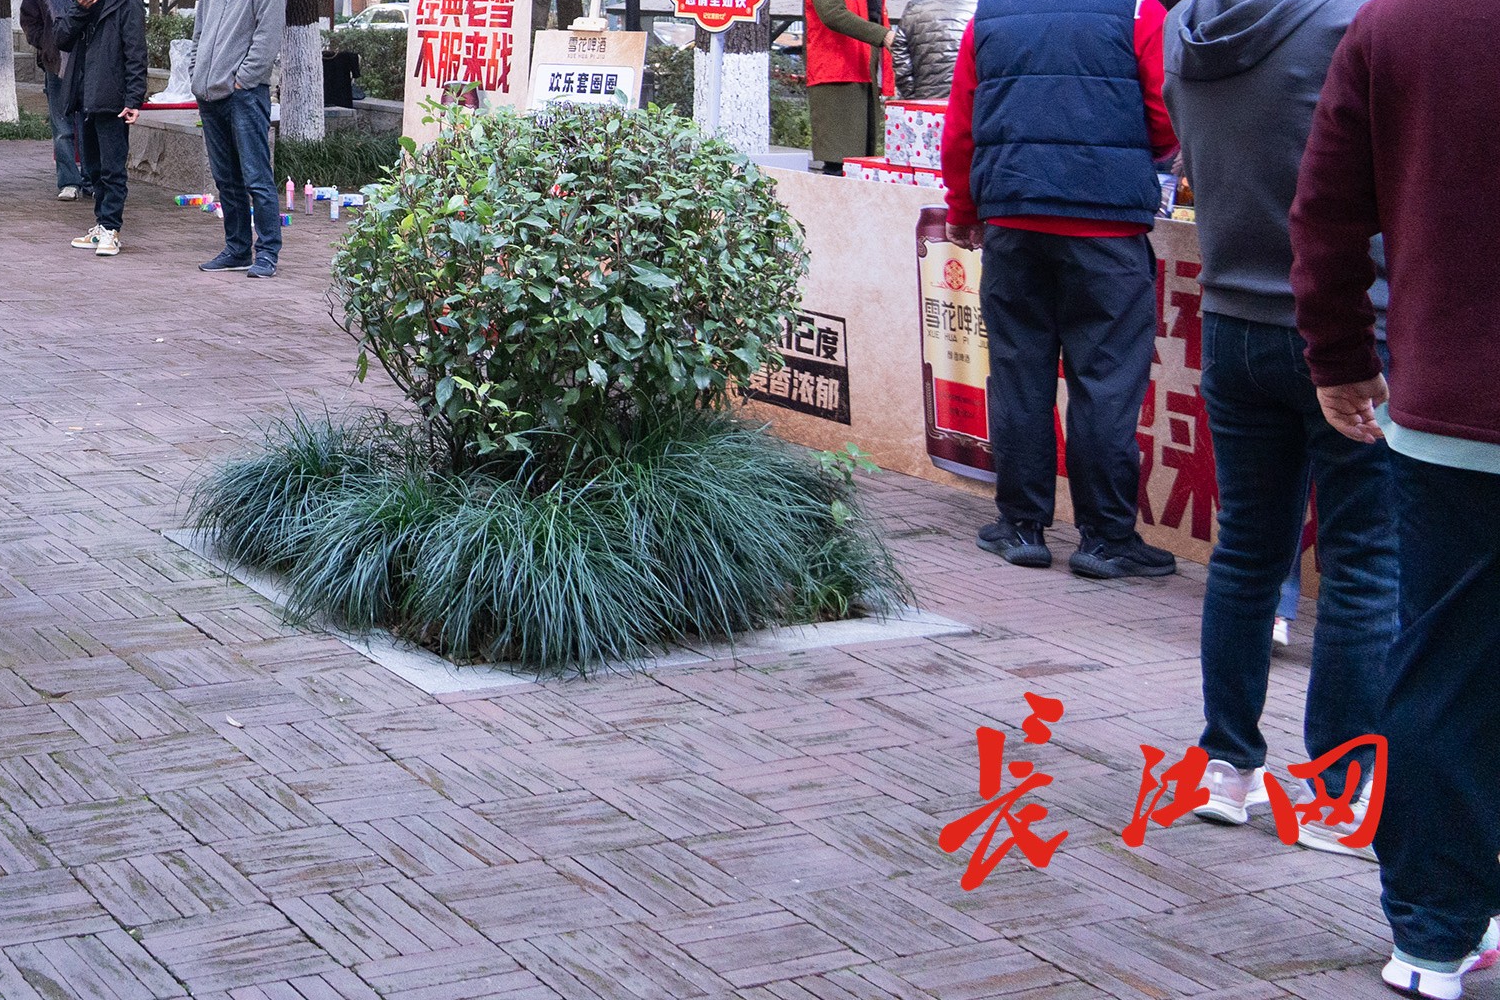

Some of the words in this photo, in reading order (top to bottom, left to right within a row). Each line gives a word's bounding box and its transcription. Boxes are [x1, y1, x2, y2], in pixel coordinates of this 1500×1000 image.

[568, 37, 607, 53] 雪花啤酒
[414, 30, 513, 94] 不服来战
[548, 72, 618, 95] 欢乐套圈圈
[925, 297, 988, 339] 雪花啤酒
[927, 329, 940, 339] XUE
[944, 333, 958, 343] HUA
[963, 336, 970, 345] PI
